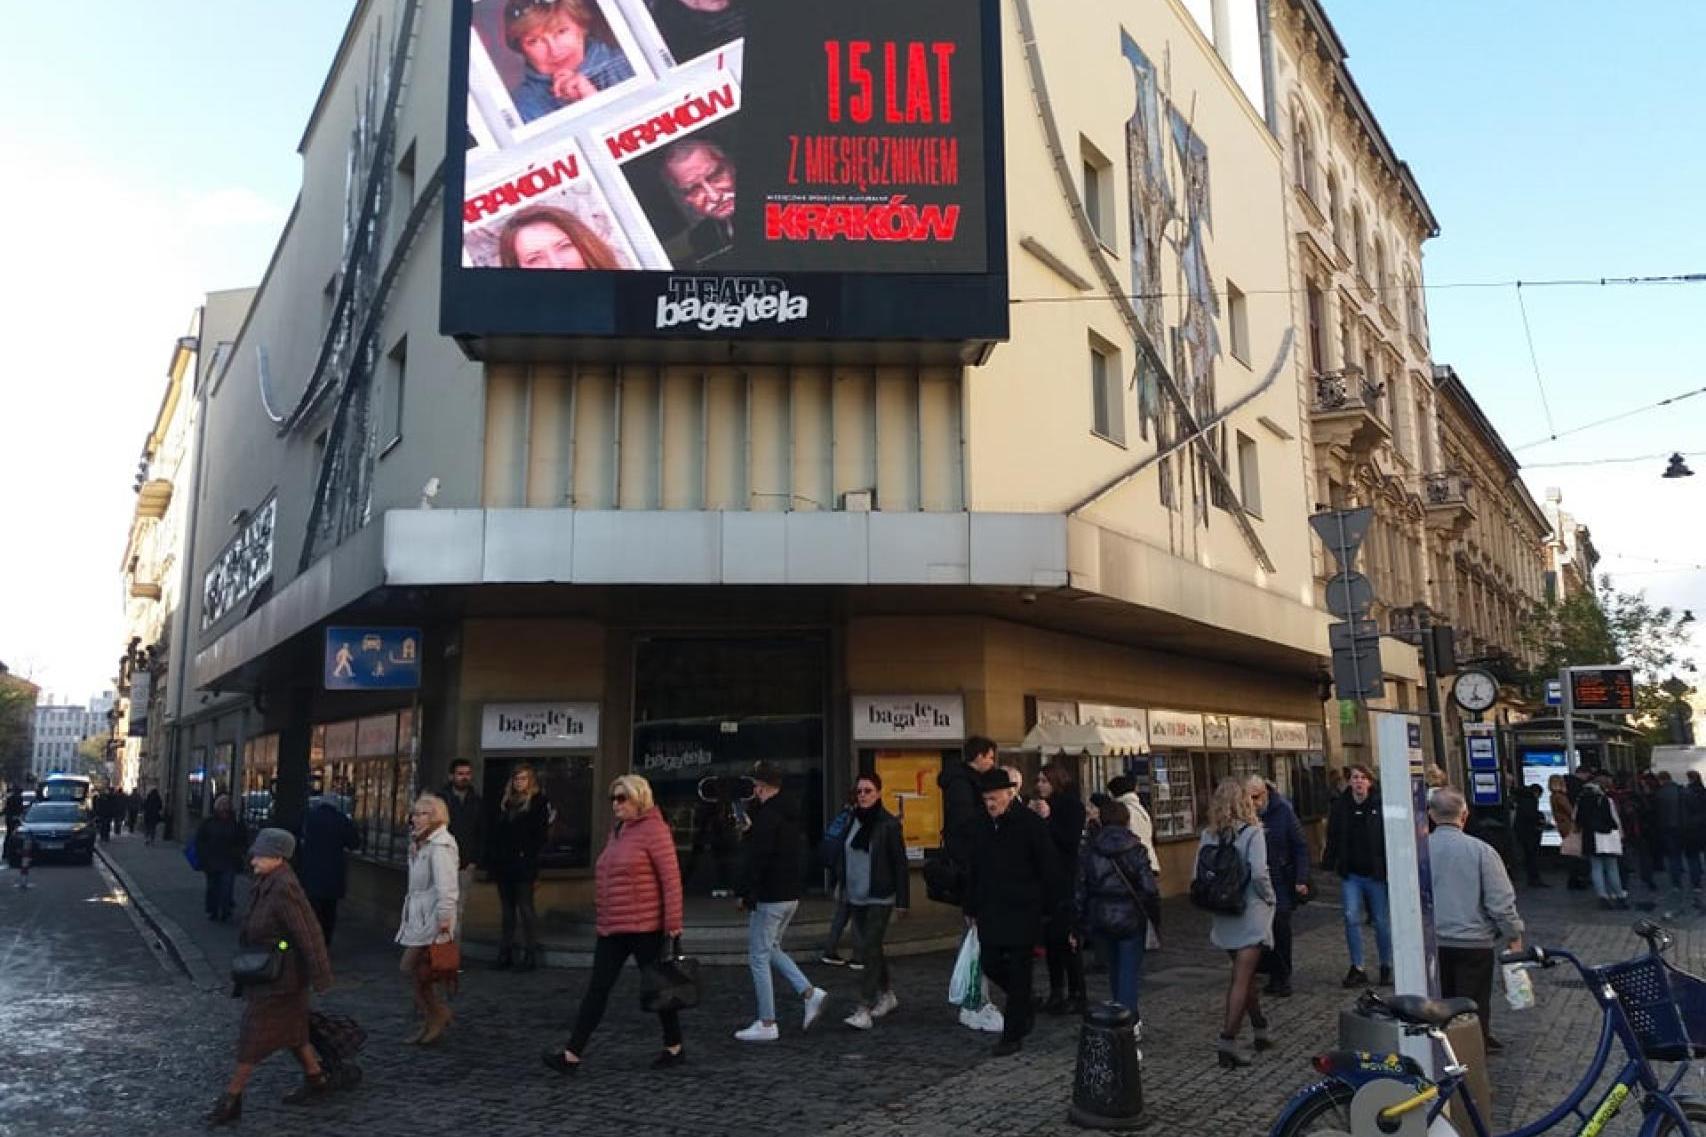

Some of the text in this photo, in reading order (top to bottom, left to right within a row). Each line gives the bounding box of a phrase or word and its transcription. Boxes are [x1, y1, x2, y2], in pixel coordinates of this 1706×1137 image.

[824, 40, 957, 124] 15 LAT
[605, 82, 735, 160] KRAKÓW
[464, 153, 579, 223] RAKÓW
[787, 135, 959, 192] Z MIESIĘCZNIKIEM
[765, 194, 962, 241] KRAKÓW
[655, 290, 809, 331] bagatela
